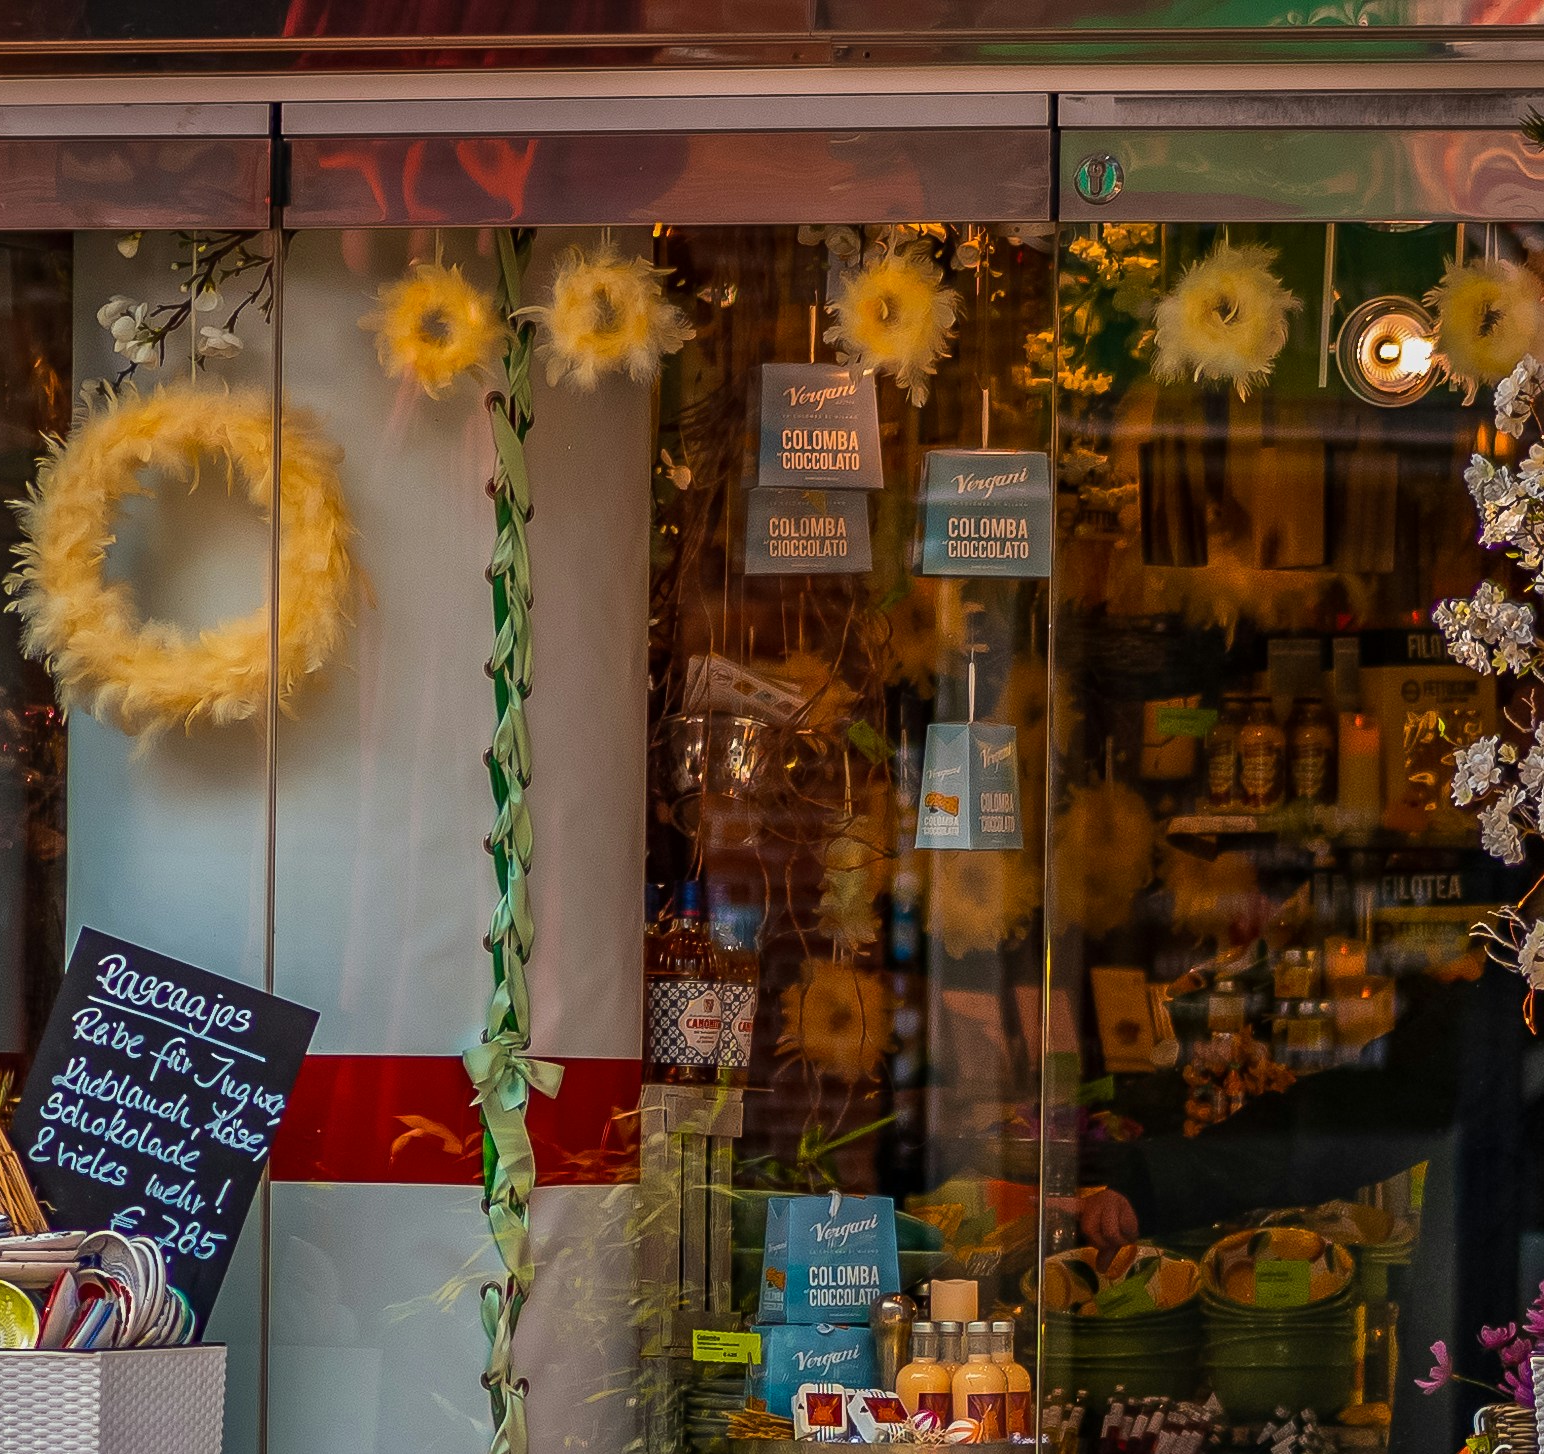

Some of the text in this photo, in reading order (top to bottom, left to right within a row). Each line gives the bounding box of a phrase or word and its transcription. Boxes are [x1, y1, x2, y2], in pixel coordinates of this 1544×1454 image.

[782, 429, 859, 450] COLOMBA
[782, 452, 860, 471] CIOCCOLATO
[950, 467, 1029, 499] Vergani
[769, 517, 847, 537] COLOMBA
[948, 517, 1029, 539] COLOMBA
[769, 539, 847, 557] CIOCCOLATO
[948, 540, 1029, 559] CIOCCOLATO
[981, 792, 1014, 813] COLOMBA
[96, 953, 252, 1036] Rascaajos
[72, 1007, 145, 1058] Reibe
[150, 1037, 194, 1081] für
[52, 1056, 200, 1141] Knoblauch,
[40, 1092, 200, 1172] Schokolade
[57, 1141, 128, 1187] vieles
[109, 1205, 146, 1233] €
[809, 1213, 879, 1247] Vergani
[809, 1265, 880, 1286] COLOMBA
[791, 1344, 861, 1376] Vergani
